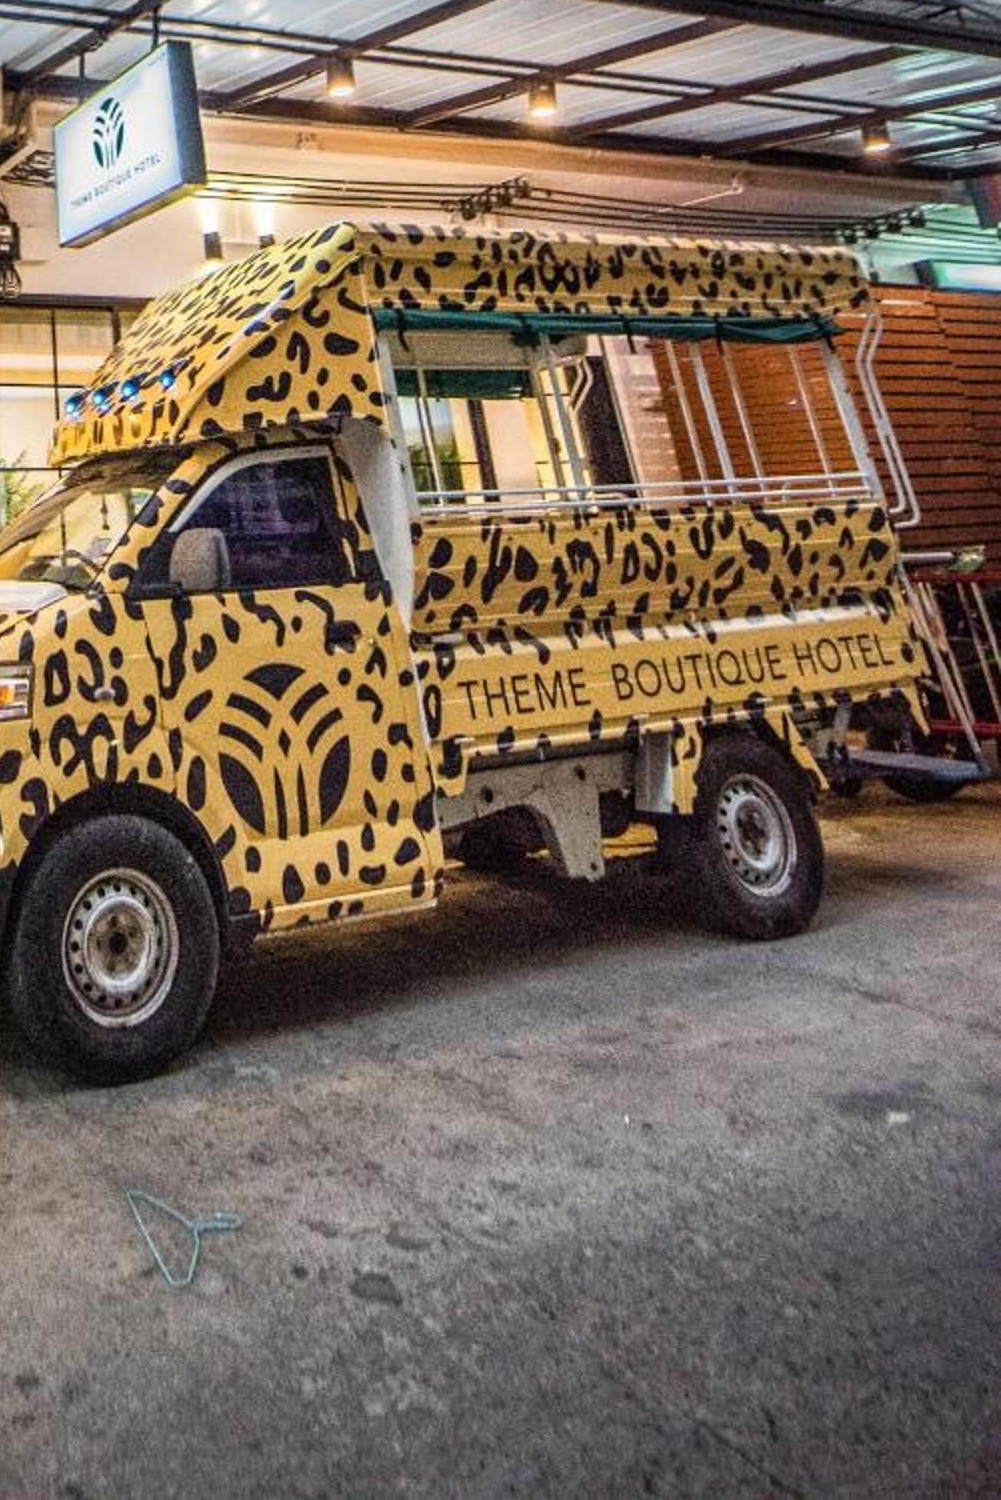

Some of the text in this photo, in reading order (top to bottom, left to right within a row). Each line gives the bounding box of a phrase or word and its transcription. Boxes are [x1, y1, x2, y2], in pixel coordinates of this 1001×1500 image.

[457, 632, 895, 720] THEME BOUTIQUE HOTEL
